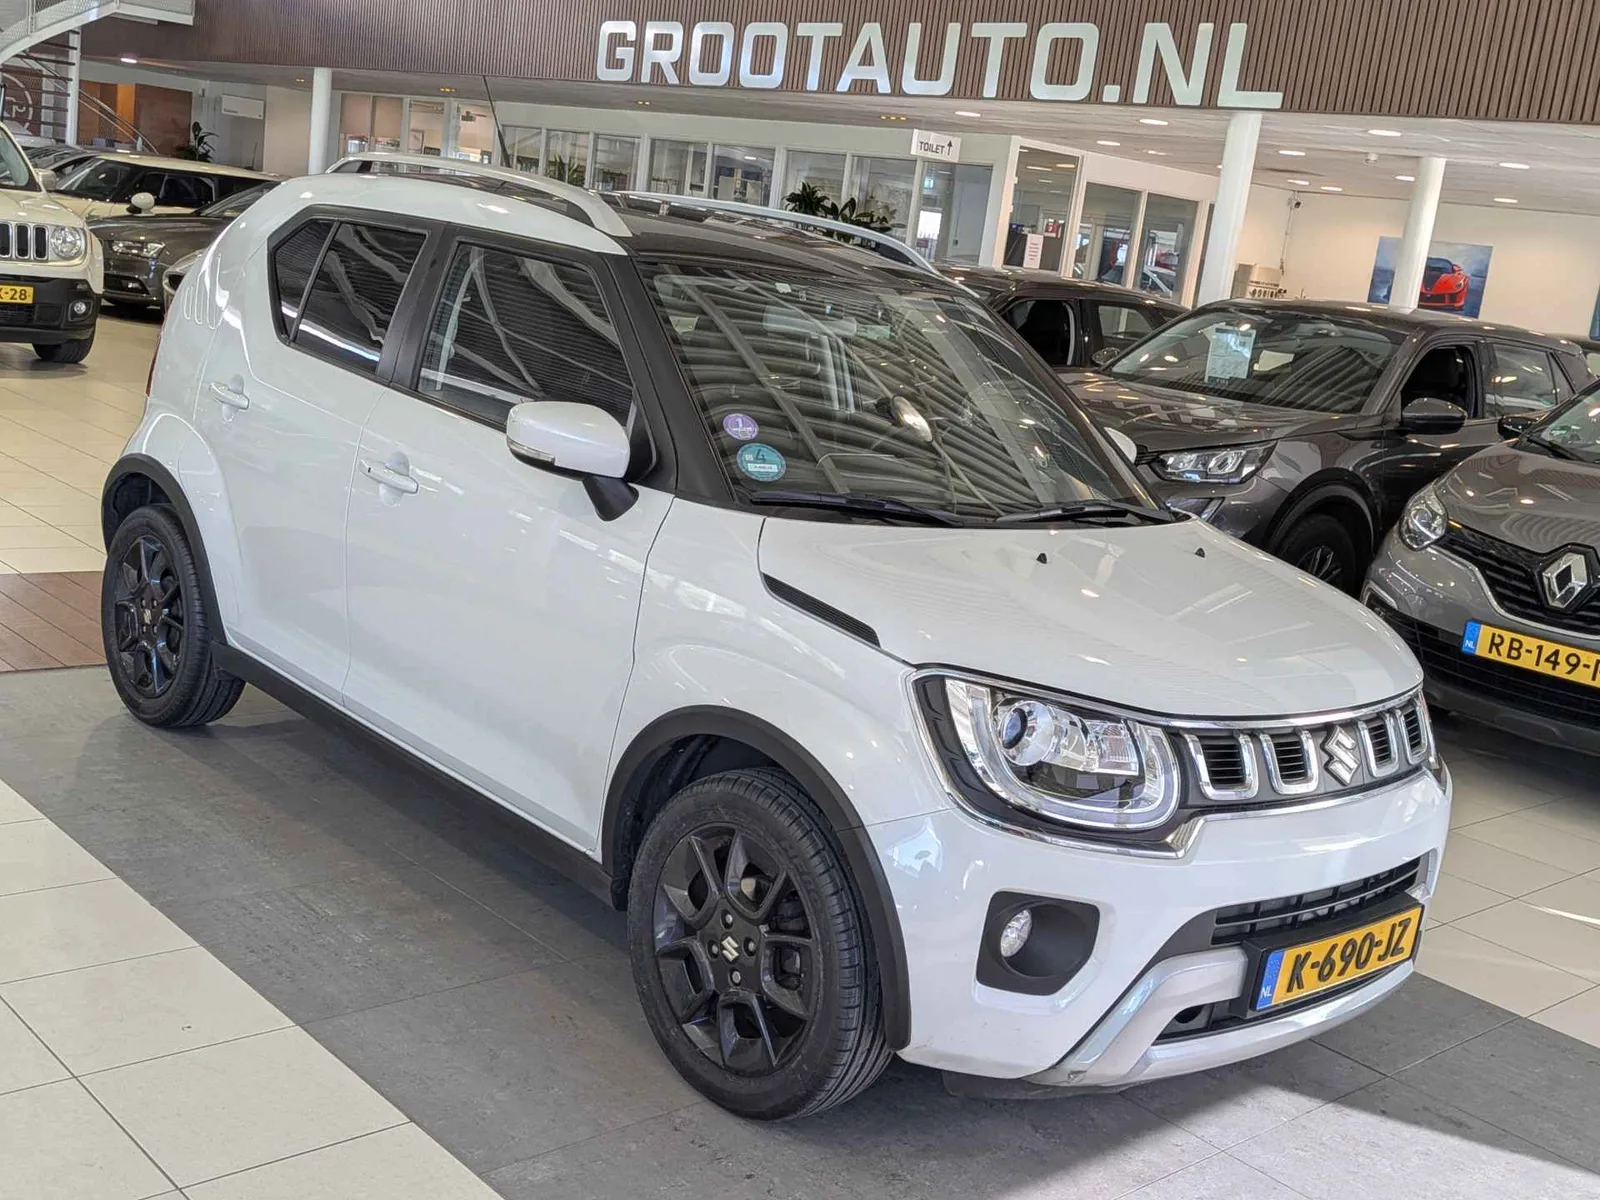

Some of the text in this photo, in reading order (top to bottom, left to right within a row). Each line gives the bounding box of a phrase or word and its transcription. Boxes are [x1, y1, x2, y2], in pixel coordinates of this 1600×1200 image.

[596, 20, 1283, 108] GROOTAUTO.NL
[919, 141, 945, 154] TOILET
[1464, 640, 1475, 649] NL
[1287, 917, 1412, 993] K-690-JZ
[1261, 985, 1273, 998] NL
